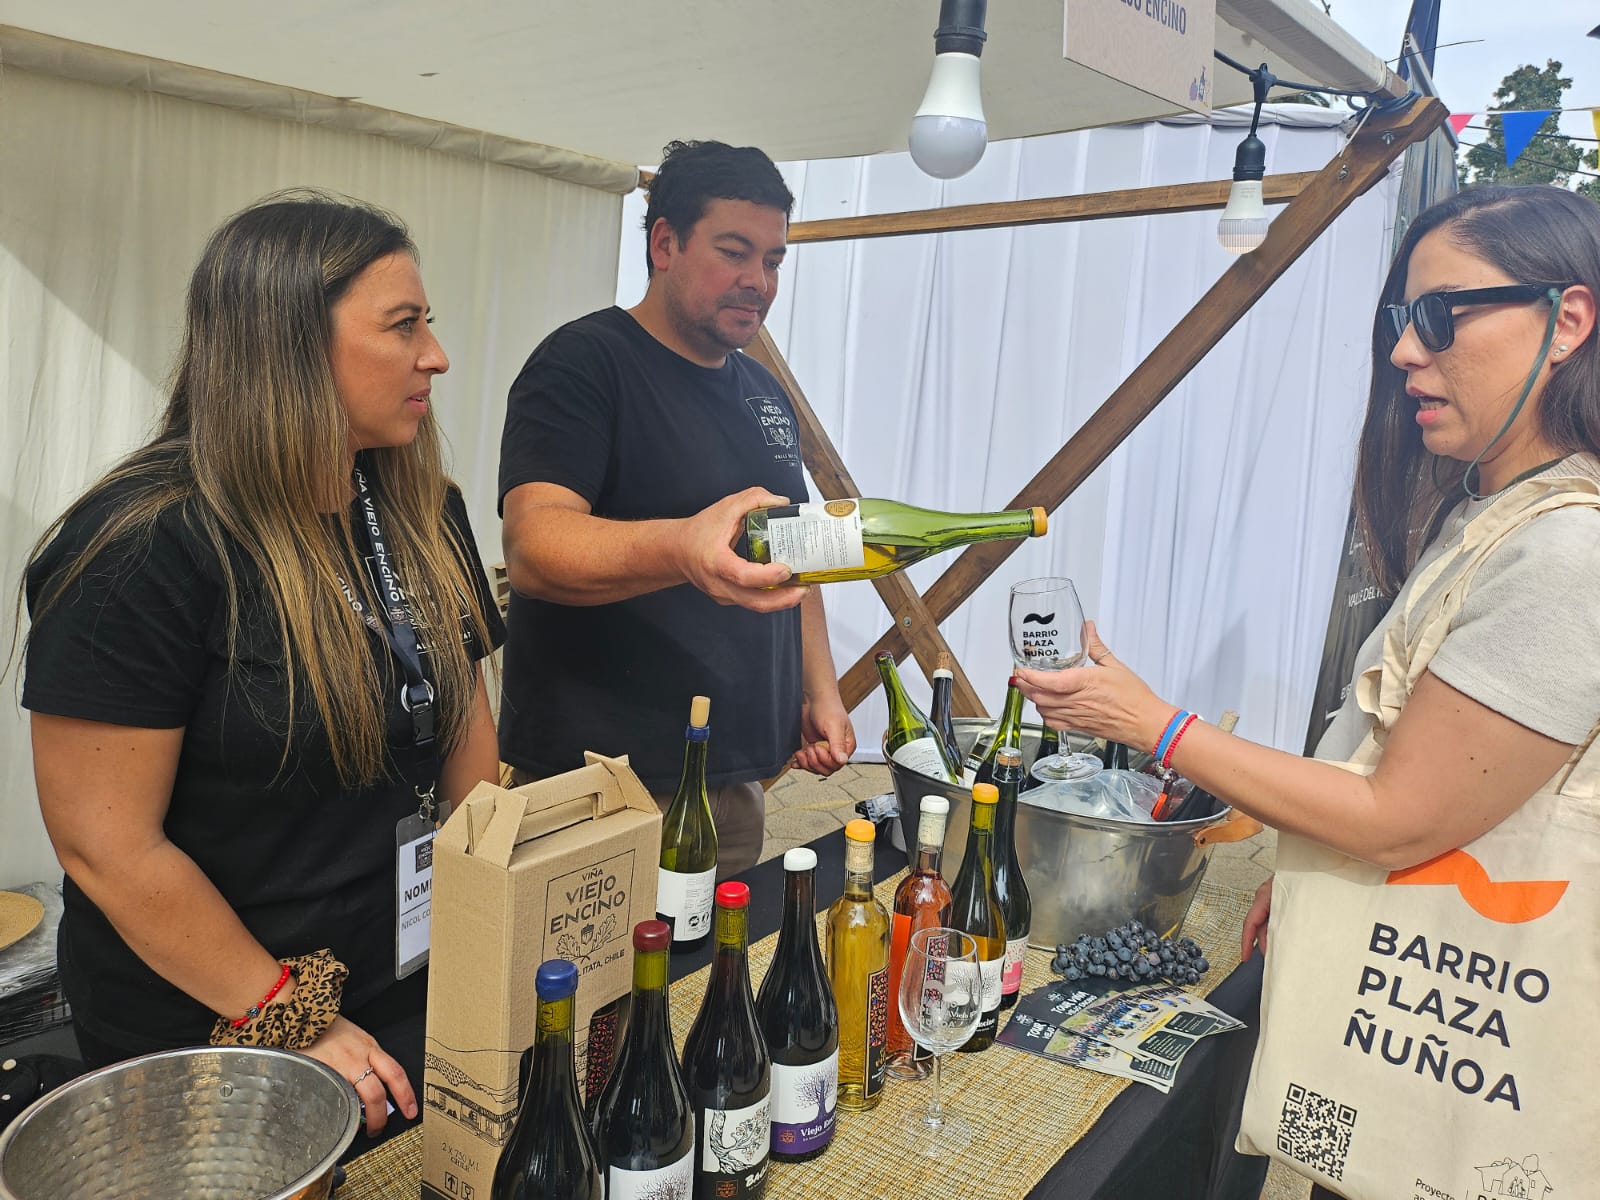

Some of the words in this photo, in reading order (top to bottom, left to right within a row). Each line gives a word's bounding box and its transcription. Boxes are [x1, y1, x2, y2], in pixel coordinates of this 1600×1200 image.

[1145, 0, 1187, 35] ENCINO
[363, 497, 381, 537] VIEJO
[374, 541, 401, 602] ENCINO
[1362, 586, 1376, 602] DEL
[1022, 629, 1059, 639] BARRIO
[1023, 639, 1055, 648] PLAZA
[1023, 648, 1060, 658] ÑUÑOA
[582, 868, 604, 882] VIÑA
[404, 878, 433, 903] NOM
[566, 874, 617, 906] VIEJO
[401, 912, 421, 932] NICOL
[550, 890, 626, 936] ENCINO
[582, 961, 603, 976] ITATA,
[604, 949, 625, 965] CHILE
[1369, 922, 1550, 1004] BARRIO
[1357, 965, 1511, 1049] PLAZA
[1343, 1008, 1521, 1111] ÑUÑOA
[801, 1124, 823, 1137] Viejo
